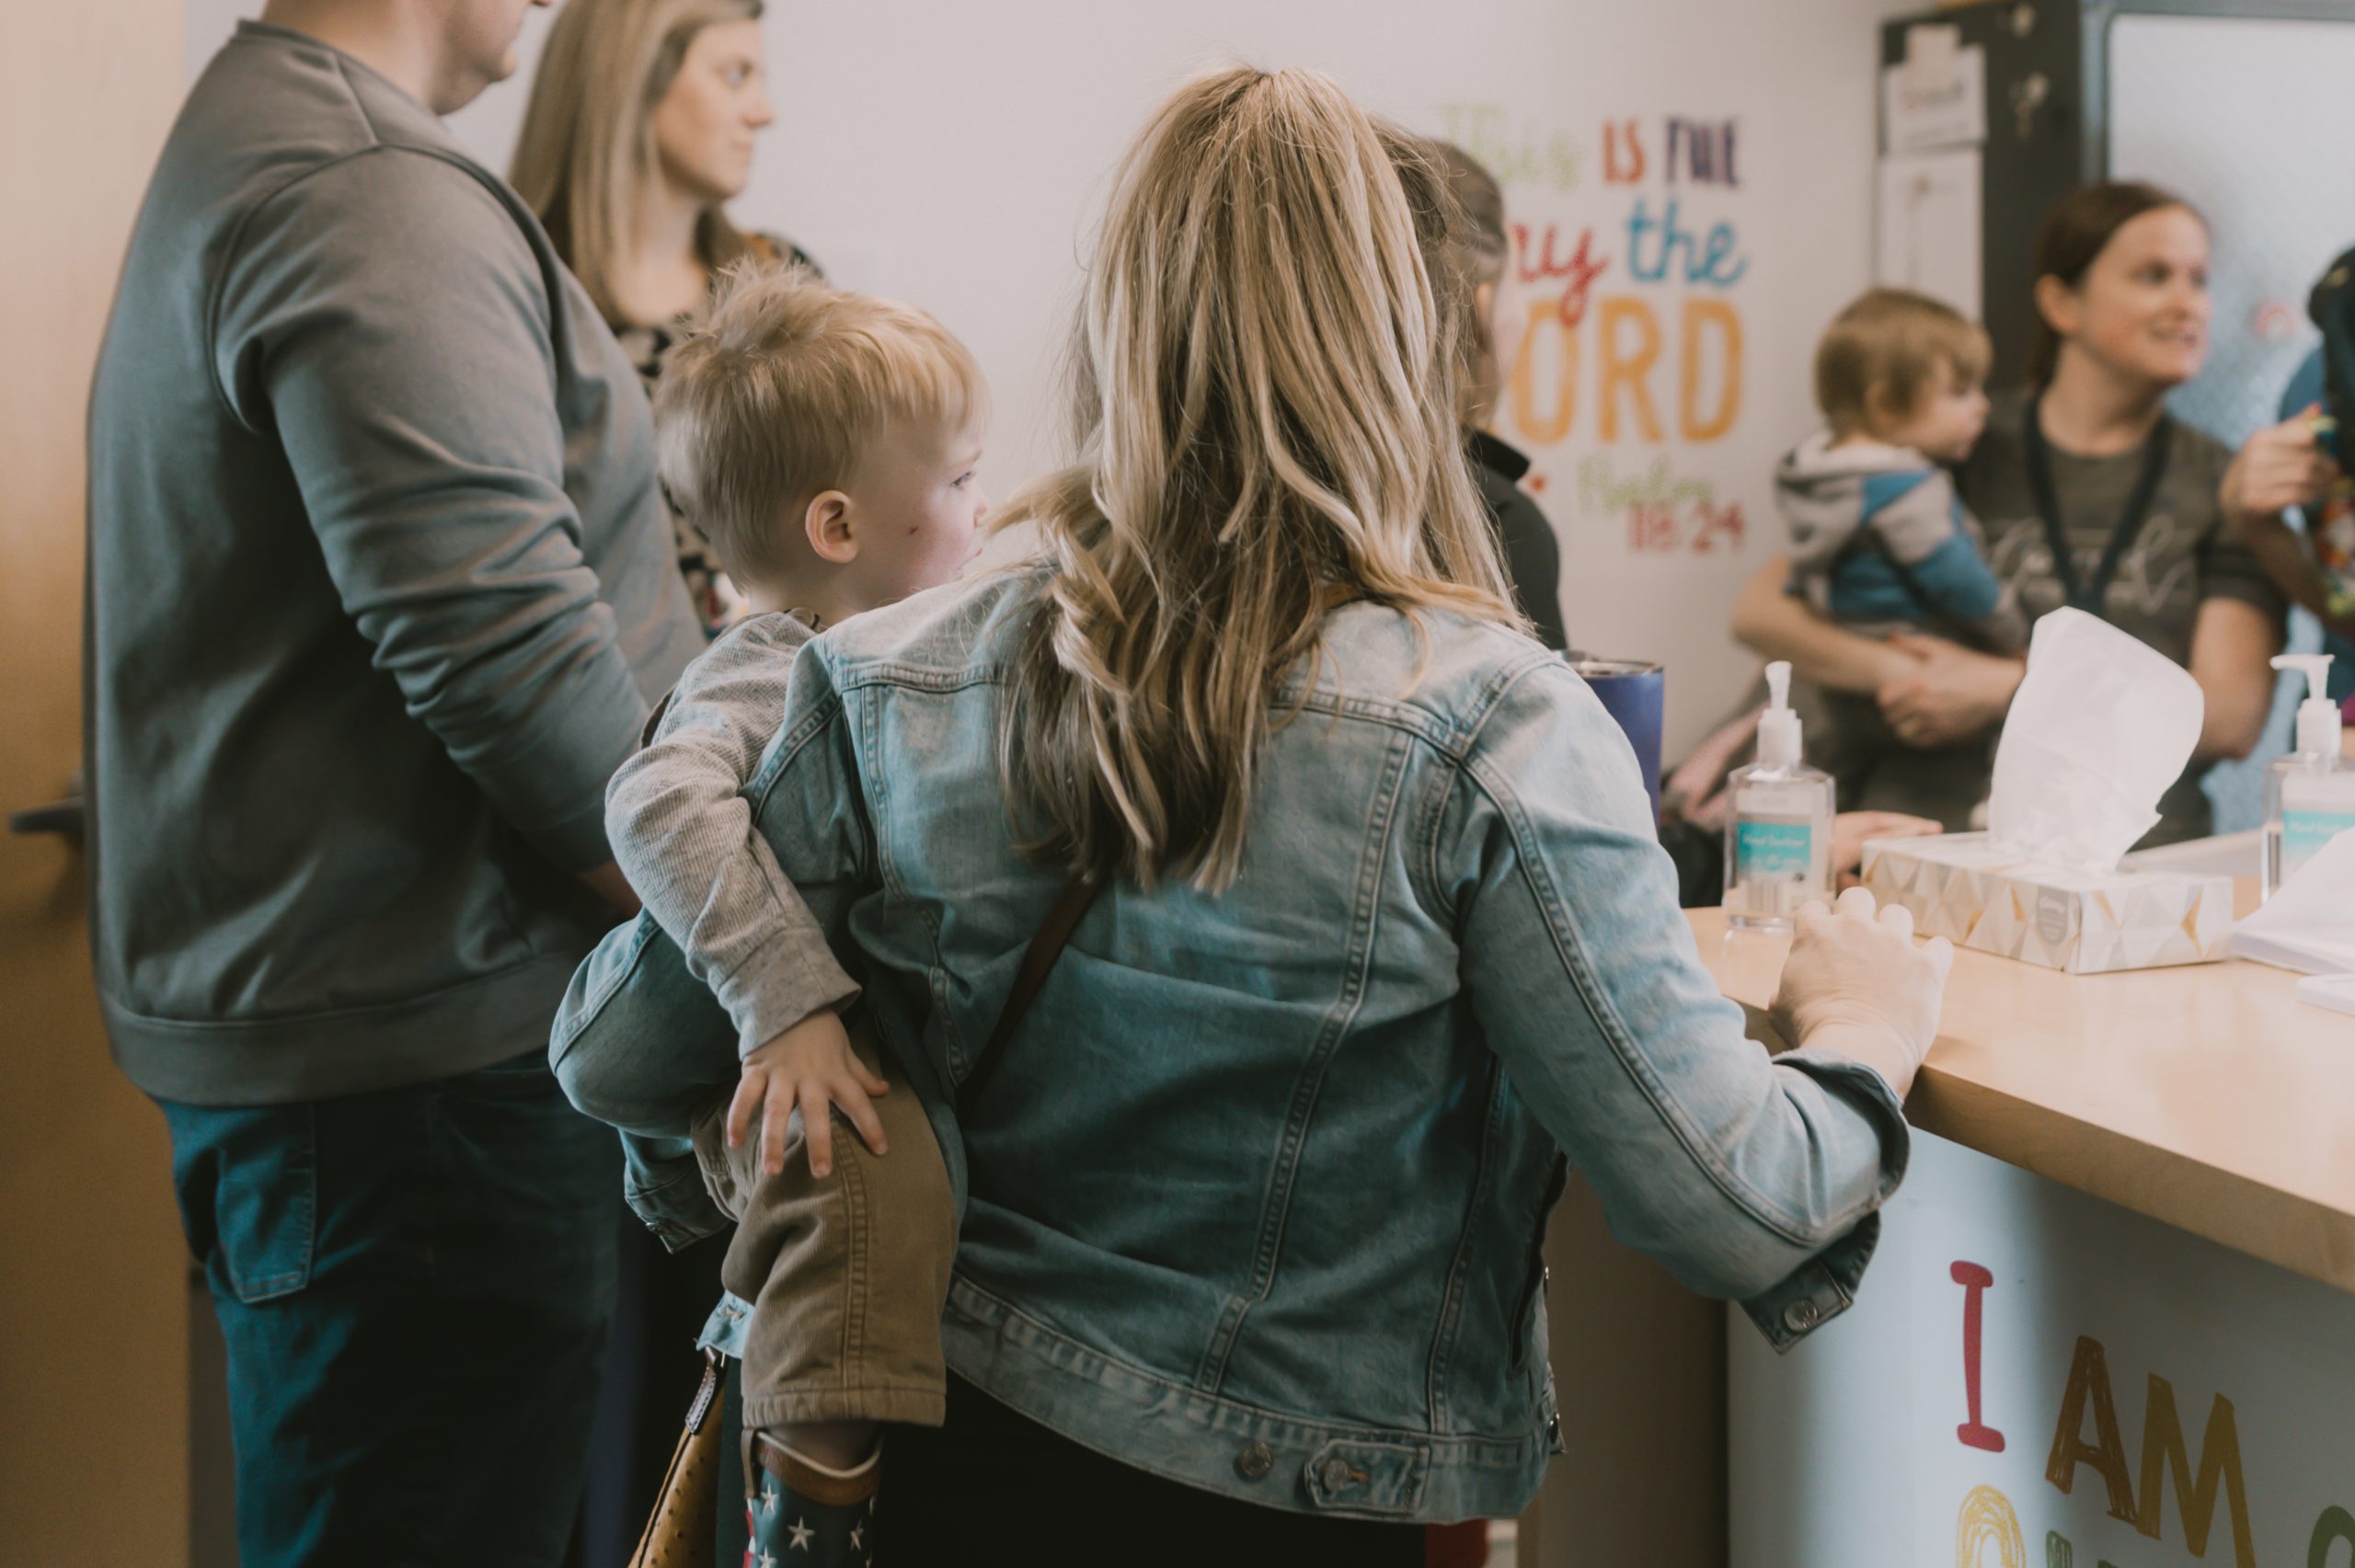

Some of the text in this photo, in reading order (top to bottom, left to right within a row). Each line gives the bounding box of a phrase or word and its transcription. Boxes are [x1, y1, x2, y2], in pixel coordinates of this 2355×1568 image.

[1603, 119, 1646, 185] IS
[1625, 195, 1750, 287] the
[1503, 296, 1744, 445] ORD
[1949, 1260, 2257, 1568] I AM
